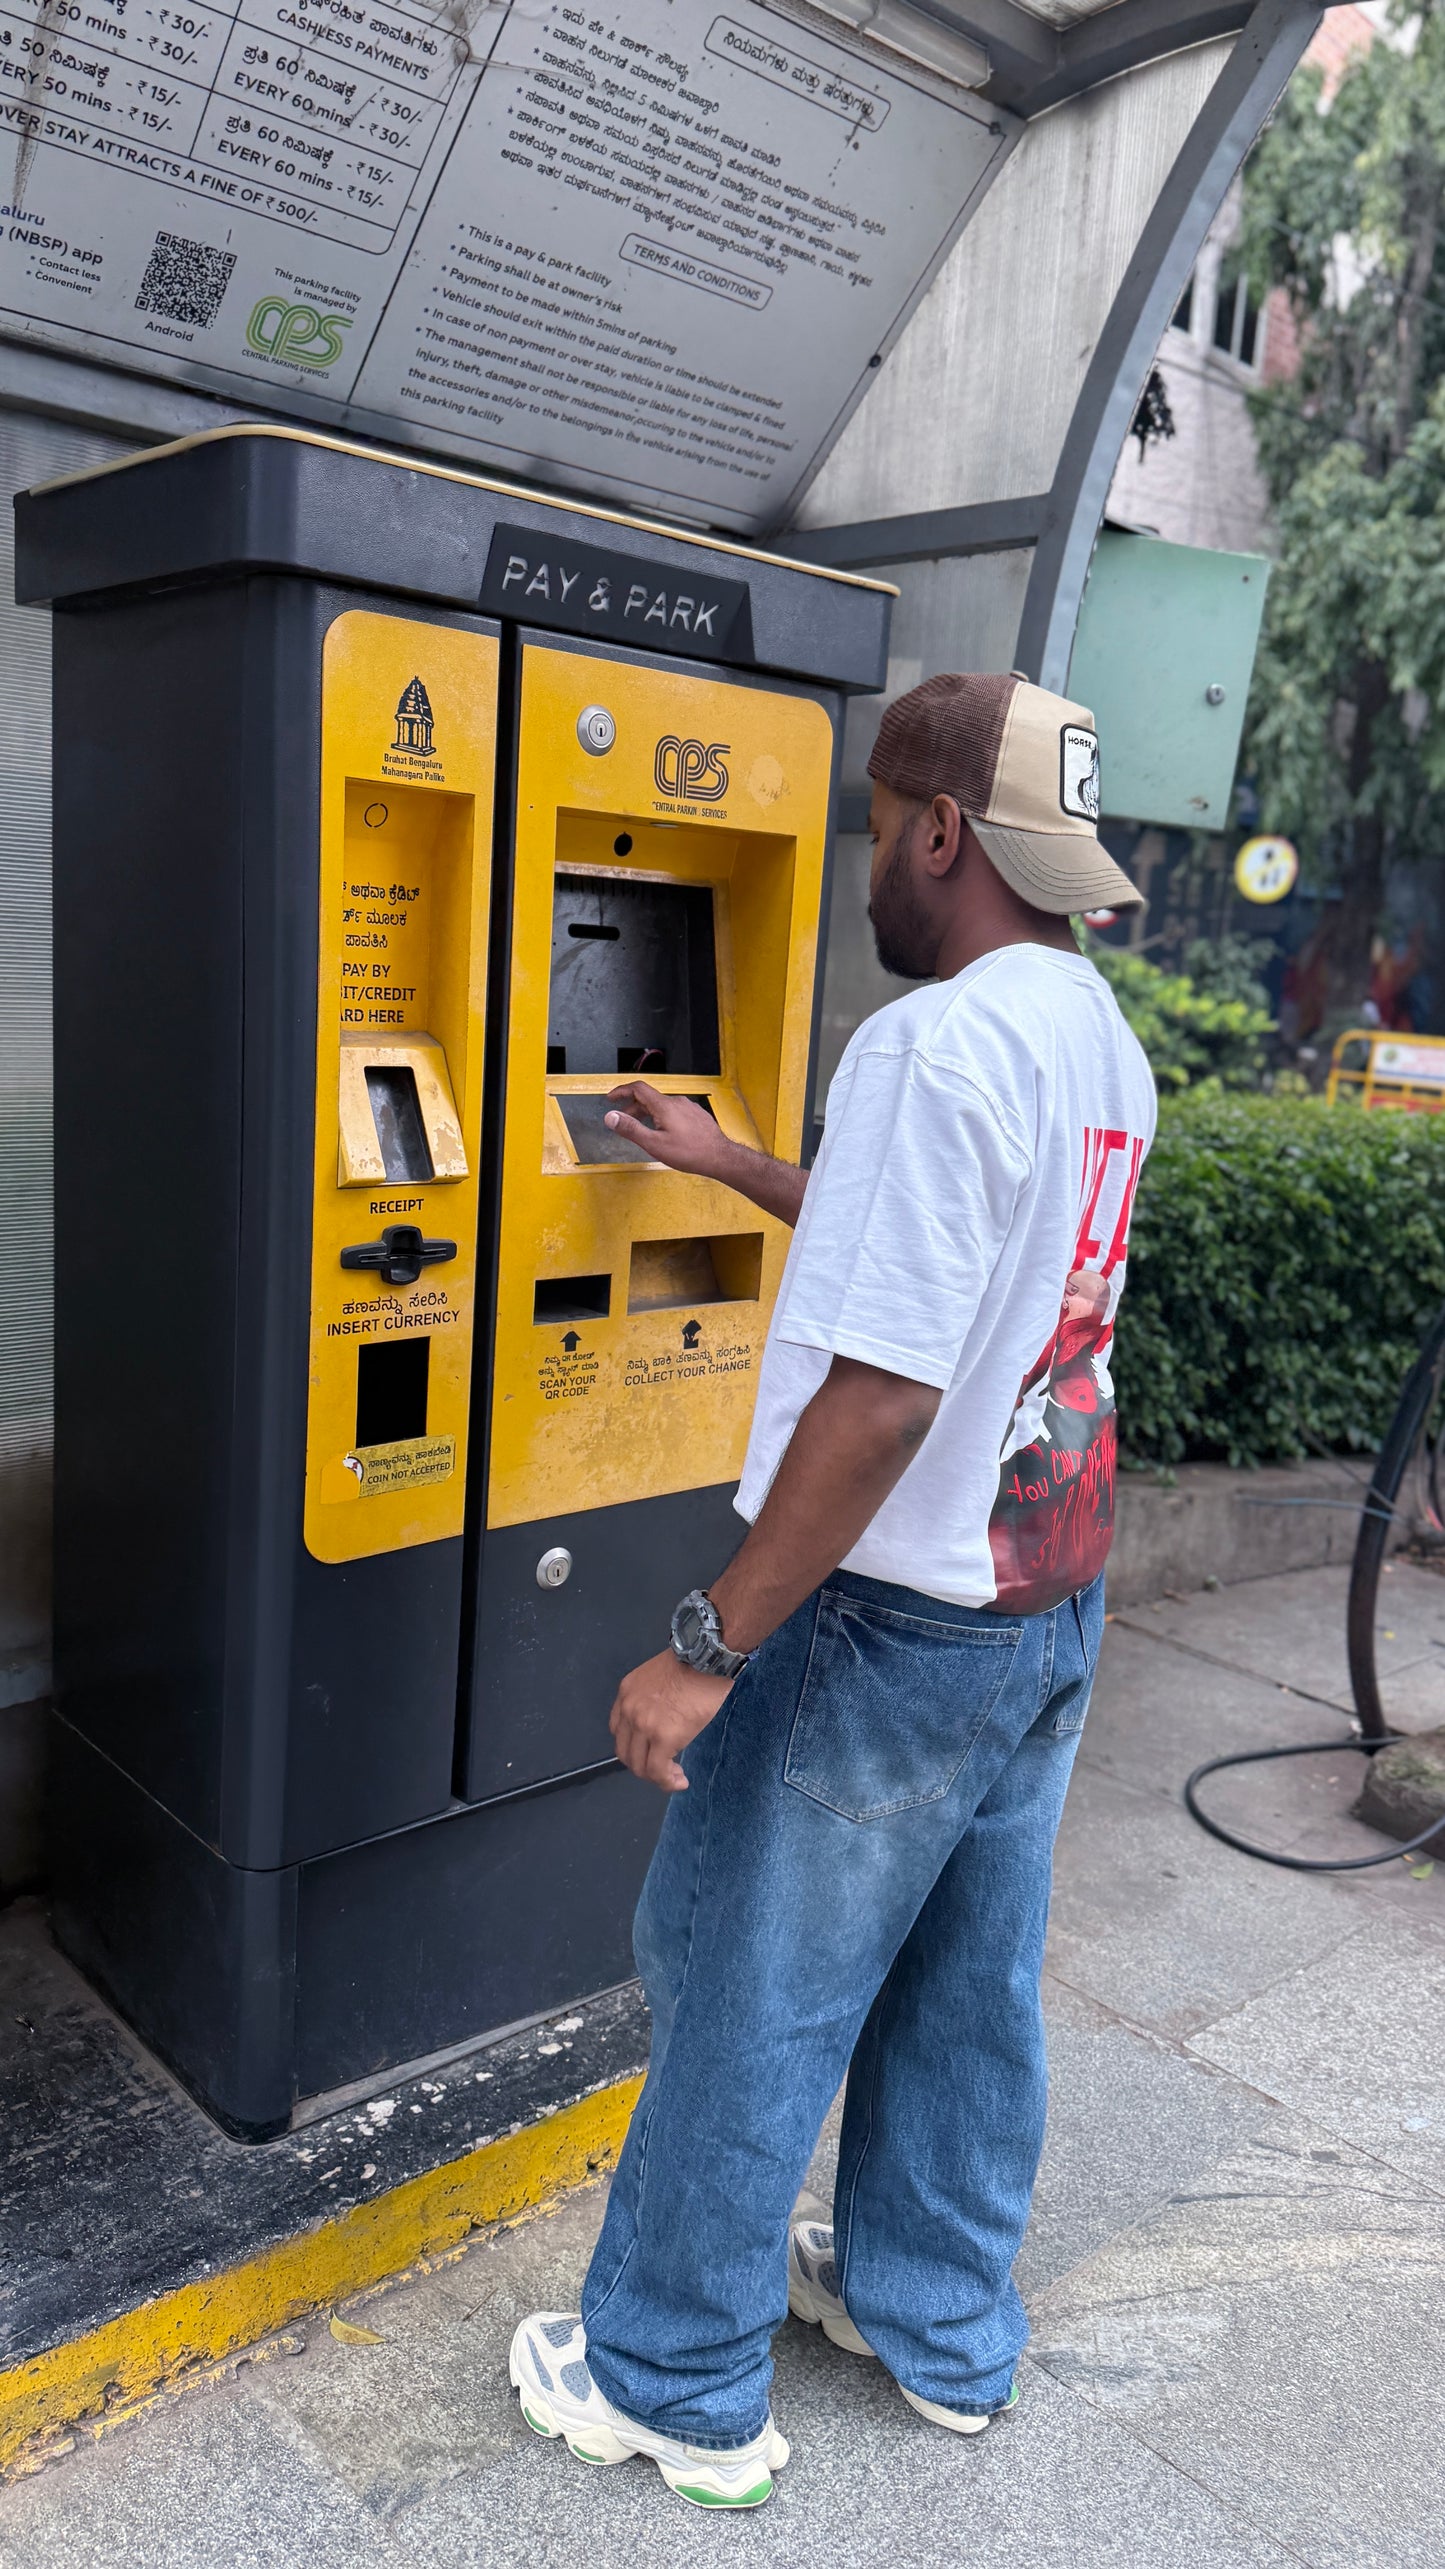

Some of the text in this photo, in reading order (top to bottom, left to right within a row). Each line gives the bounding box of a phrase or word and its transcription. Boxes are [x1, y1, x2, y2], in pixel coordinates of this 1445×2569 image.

[85, 15, 127, 40] mins
[276, 8, 353, 49] CASHLESS
[354, 40, 430, 81] PAYMENTS
[2, 61, 40, 85] ERY
[42, 75, 67, 95] 50
[71, 89, 112, 112] mins
[233, 71, 290, 102] EVERY
[291, 93, 315, 114] 60
[314, 105, 354, 128] mins
[44, 120, 90, 145] STAY
[91, 137, 181, 177] ATTRACTS
[183, 169, 195, 183] A
[199, 173, 238, 197] FINE
[240, 188, 264, 204] OF
[216, 138, 272, 167] EVERY
[274, 159, 296, 177] 60
[297, 171, 334, 191] mins
[9, 226, 68, 256] (NBSP)
[72, 247, 103, 265] app
[468, 224, 612, 287] This is a pay & park facility
[39, 257, 101, 281] Contact less
[457, 246, 502, 272] Parking
[503, 264, 532, 281] shall
[531, 273, 546, 286] be
[547, 280, 560, 291] at
[602, 299, 623, 314] risk
[633, 243, 761, 301] TERMS AND CONDITIONS
[35, 271, 92, 294] Convenient
[275, 267, 361, 303] This parking facility
[294, 287, 358, 314] is managed by
[448, 266, 678, 355] Payment to be made within 5mins of parking
[144, 320, 194, 342] Android
[442, 287, 783, 410] Vehicle should exit within the paid duration or time should be extended
[241, 349, 330, 380] CENTRAL PARKING SERVICES
[400, 386, 505, 425] this parking facility
[501, 555, 722, 638] PAY & PARK
[381, 766, 423, 780] Mahanagara
[409, 756, 443, 770] Bengaluru
[677, 805, 701, 816] PARKIN
[701, 807, 728, 819] SERVICES
[351, 882, 386, 900] ಅಥವಾ
[366, 908, 407, 926] ಮೂಲಕ
[345, 932, 388, 948] ಪಾವತಿಸಿ
[342, 963, 391, 978] PAY BY
[341, 986, 416, 1001] IT/CREDIT
[368, 1010, 404, 1023] HERE
[370, 1199, 424, 1214] RECEIPT
[342, 1295, 403, 1315] ಹಣವನ್ನು
[327, 1311, 460, 1336] INSERT CURRENCY
[539, 1375, 597, 1390] SCAN YOUR
[625, 1359, 751, 1386] COLLECT YOUR CHANGE
[545, 1386, 590, 1400] QR CODE
[367, 1462, 451, 1485] COIN NOT ACCEPTED
[1007, 1473, 1049, 1504] YOU
